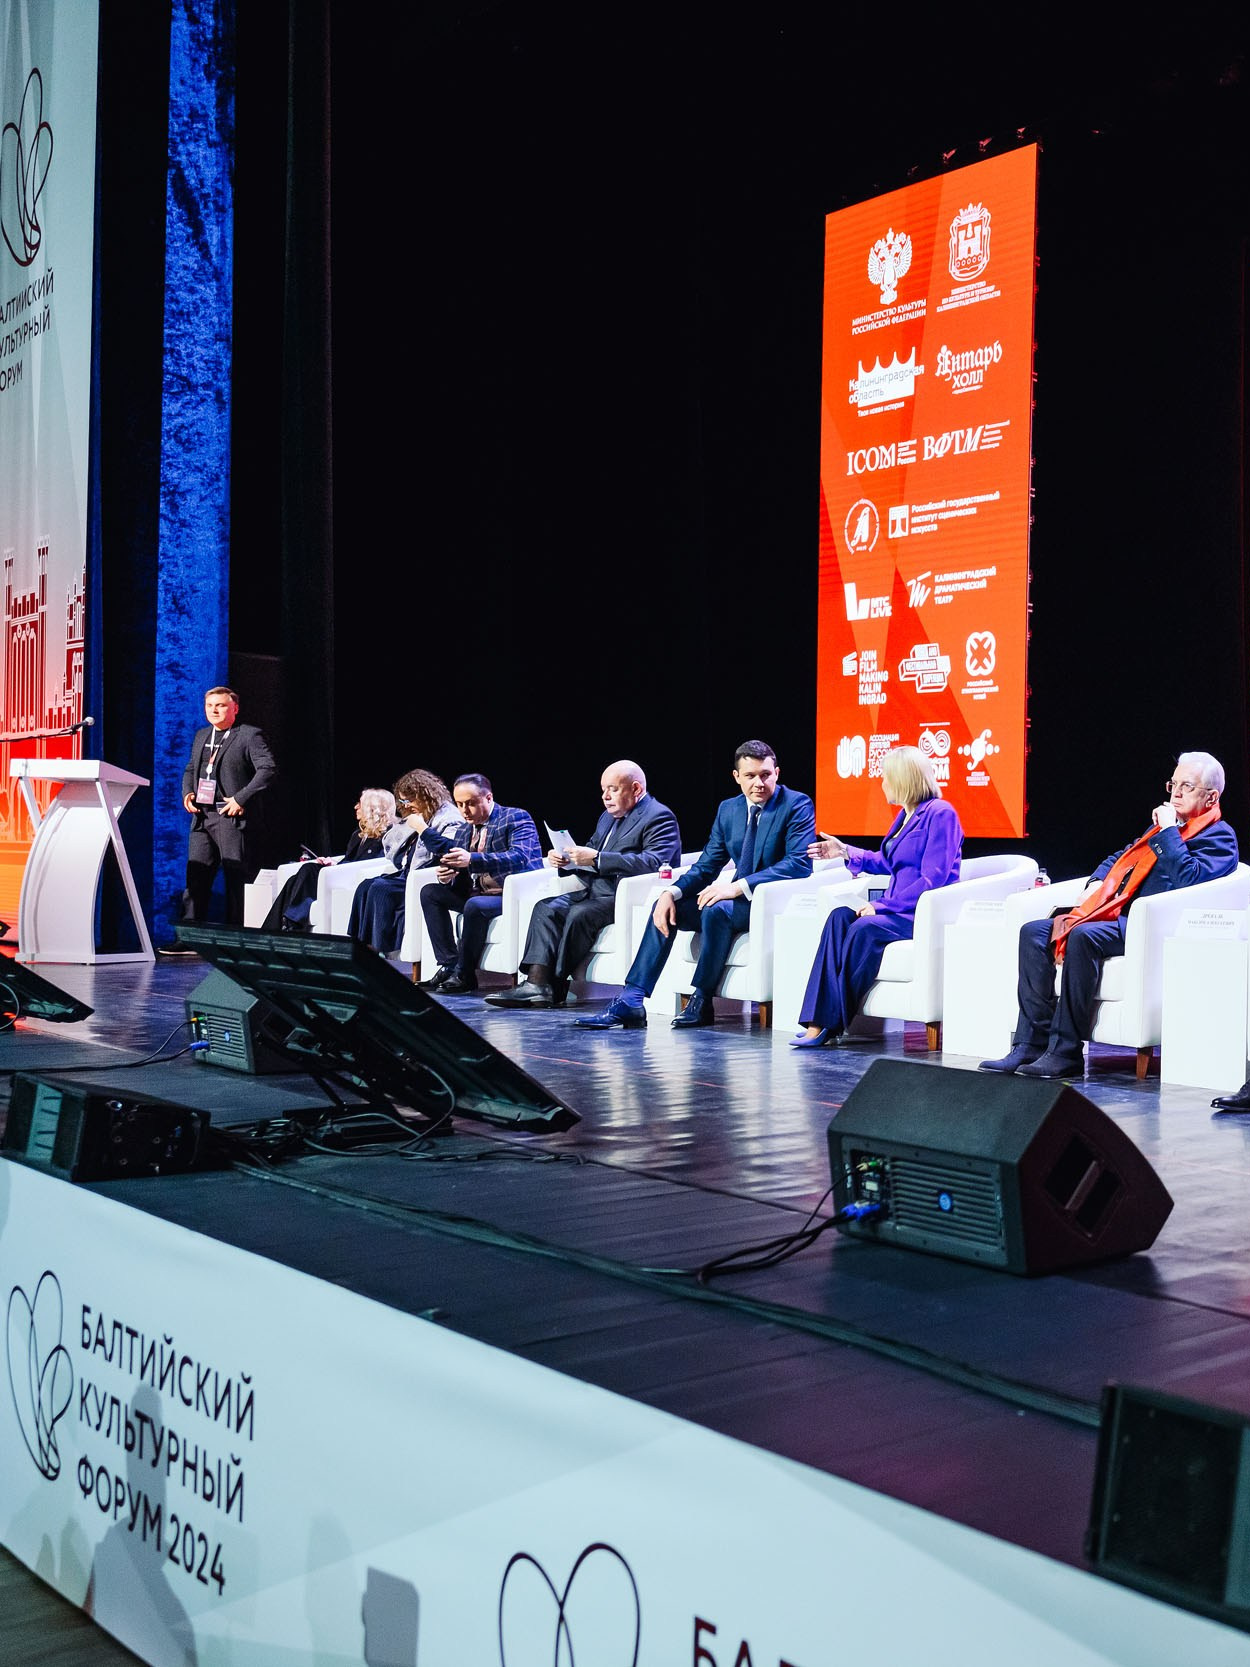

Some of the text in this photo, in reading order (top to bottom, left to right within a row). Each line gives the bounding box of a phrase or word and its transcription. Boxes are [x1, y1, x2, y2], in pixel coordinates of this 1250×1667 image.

[851, 298, 927, 326] МИНИСТЕРСТВО КУЛЬТУРЫ
[851, 308, 927, 336] РОССИЙСКОЙ ФЕДЕРАЦИИ
[849, 364, 925, 392] Калининградская
[848, 389, 885, 405] область
[846, 443, 896, 476] ICOM
[870, 606, 892, 618] LIVE
[859, 650, 877, 661] JOIN
[859, 661, 878, 672] FILM
[858, 671, 889, 683] MAKING
[858, 683, 882, 694] KALIN
[858, 693, 887, 705] INGRAD
[80, 1303, 254, 1441] БАЛТИЙСКИЙ
[79, 1377, 244, 1523] КУЛЬТУРНЫЙ
[77, 1454, 225, 1596] ФОРУМ 2024
